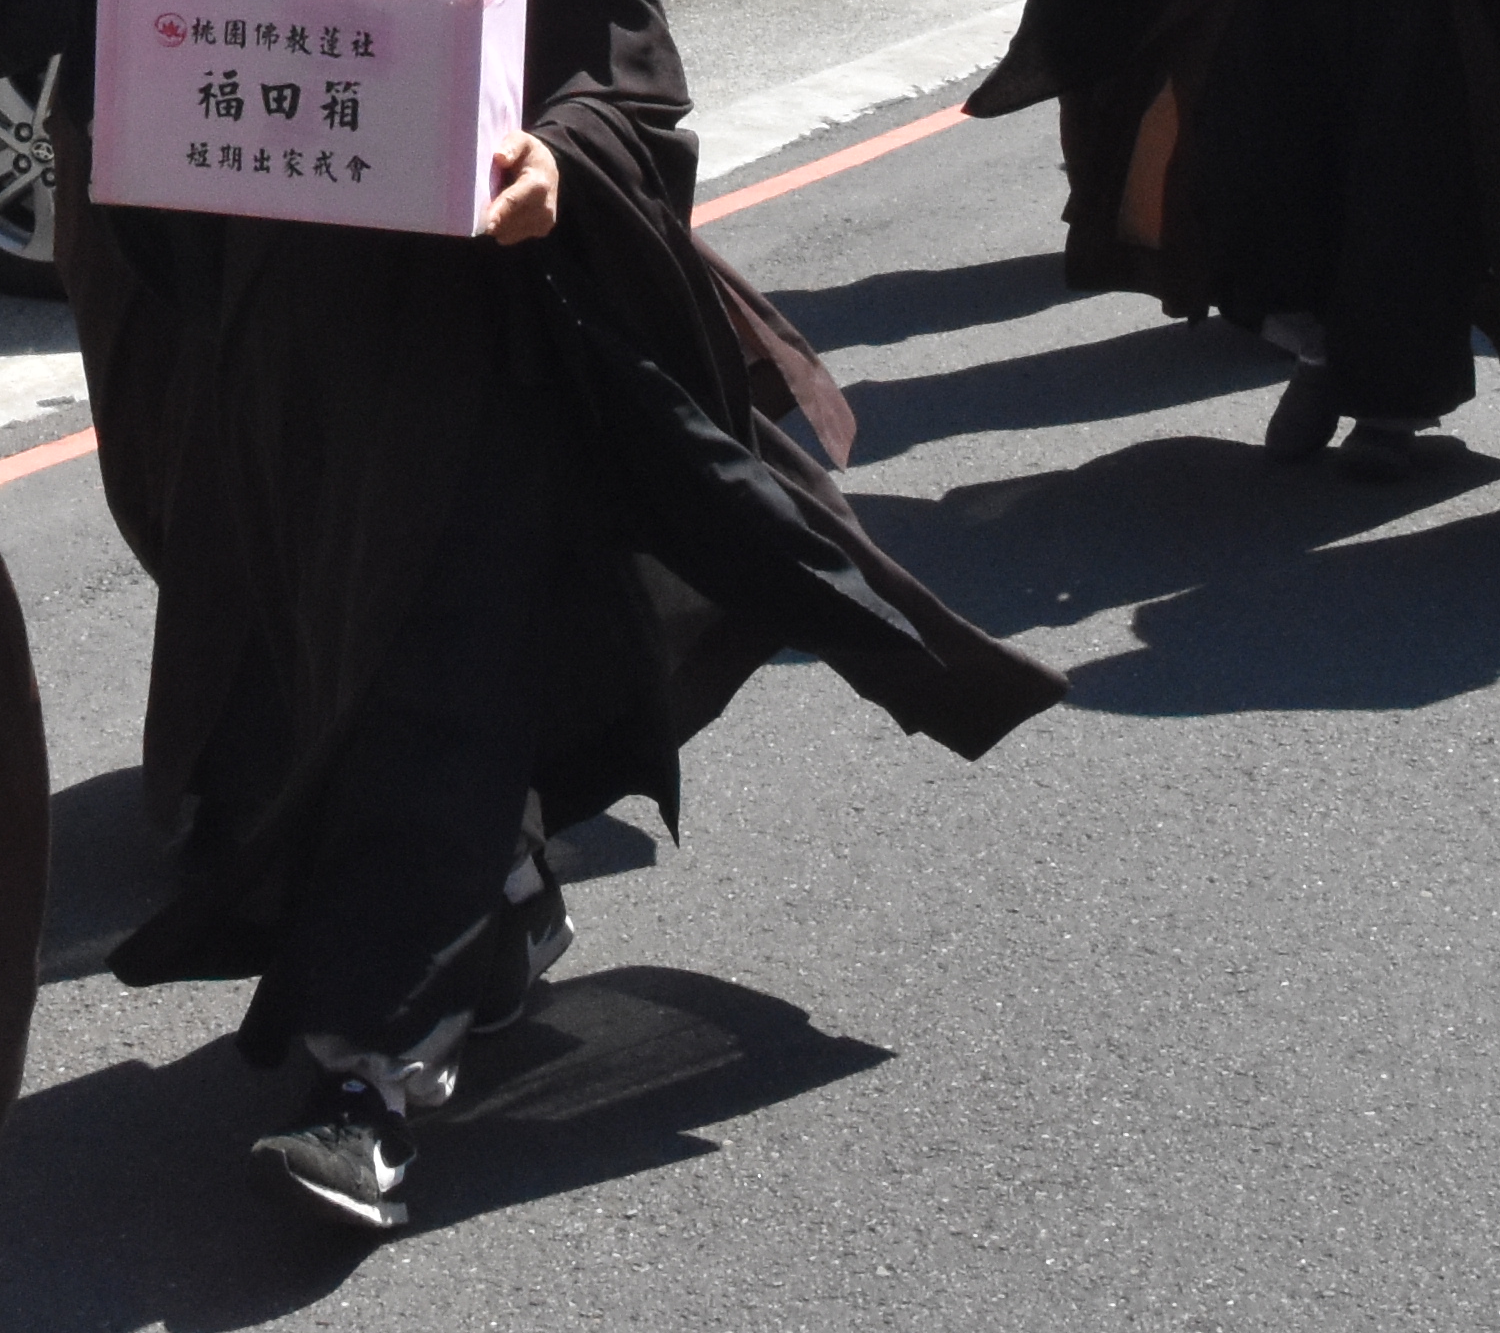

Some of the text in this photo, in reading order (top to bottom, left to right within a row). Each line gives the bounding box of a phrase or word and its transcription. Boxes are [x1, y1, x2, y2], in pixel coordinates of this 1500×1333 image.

[190, 17, 377, 60] 桃園佛教蓮社
[197, 69, 363, 132] 福田箱
[186, 143, 372, 184] 短期出家戒會
